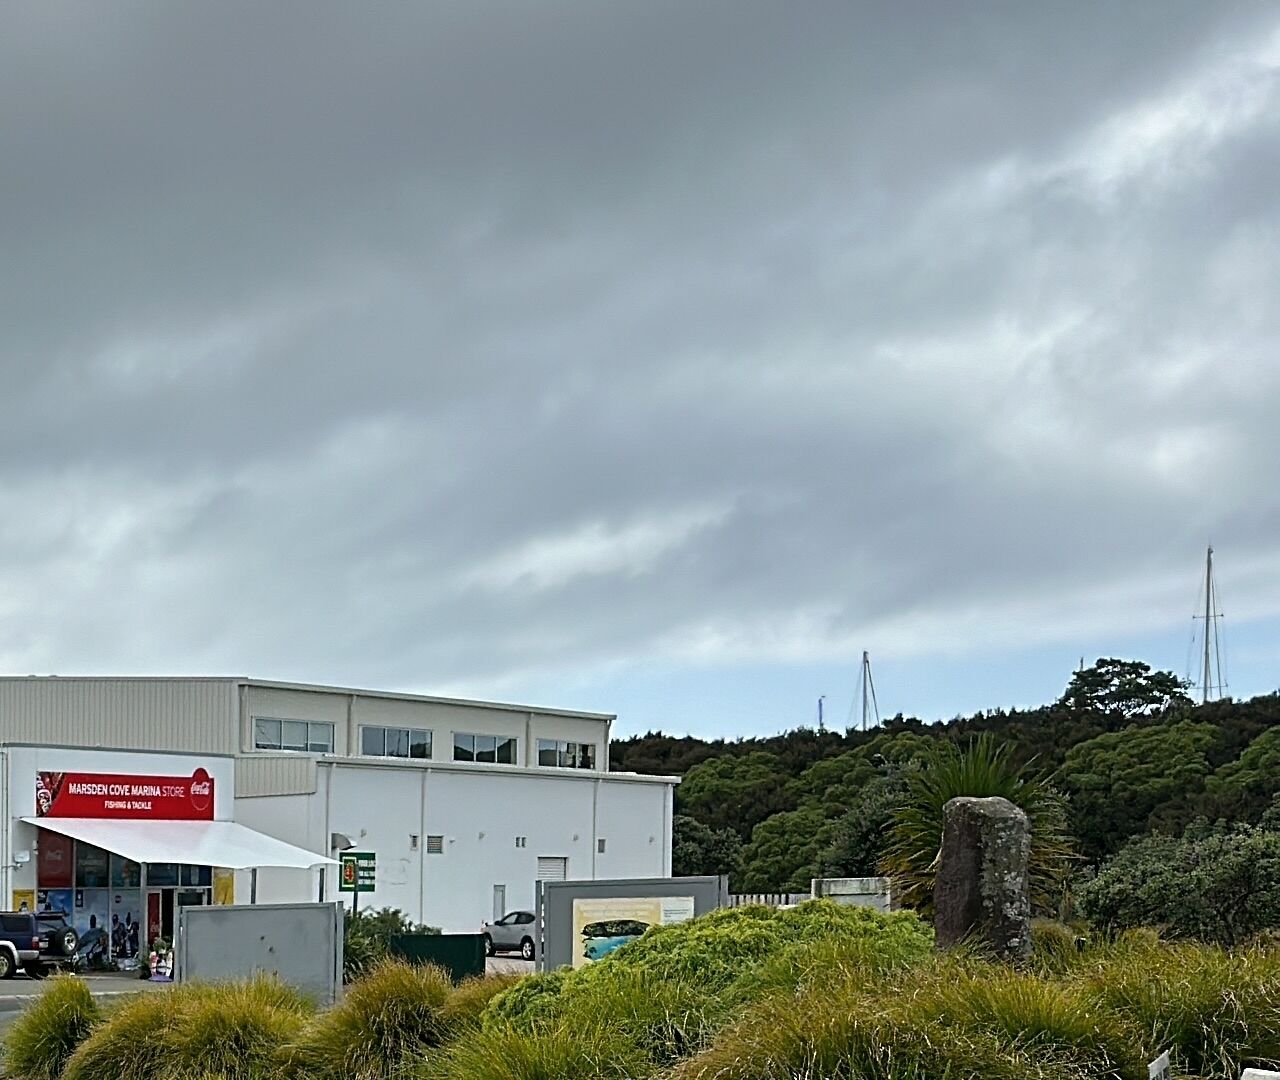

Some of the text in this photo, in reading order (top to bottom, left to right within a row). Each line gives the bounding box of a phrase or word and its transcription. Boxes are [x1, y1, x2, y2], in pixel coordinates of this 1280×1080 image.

[68, 782, 185, 798] MARSDEN COVE MARINA STORE
[104, 800, 126, 809] FISHING
[132, 801, 152, 810] TACKLE
